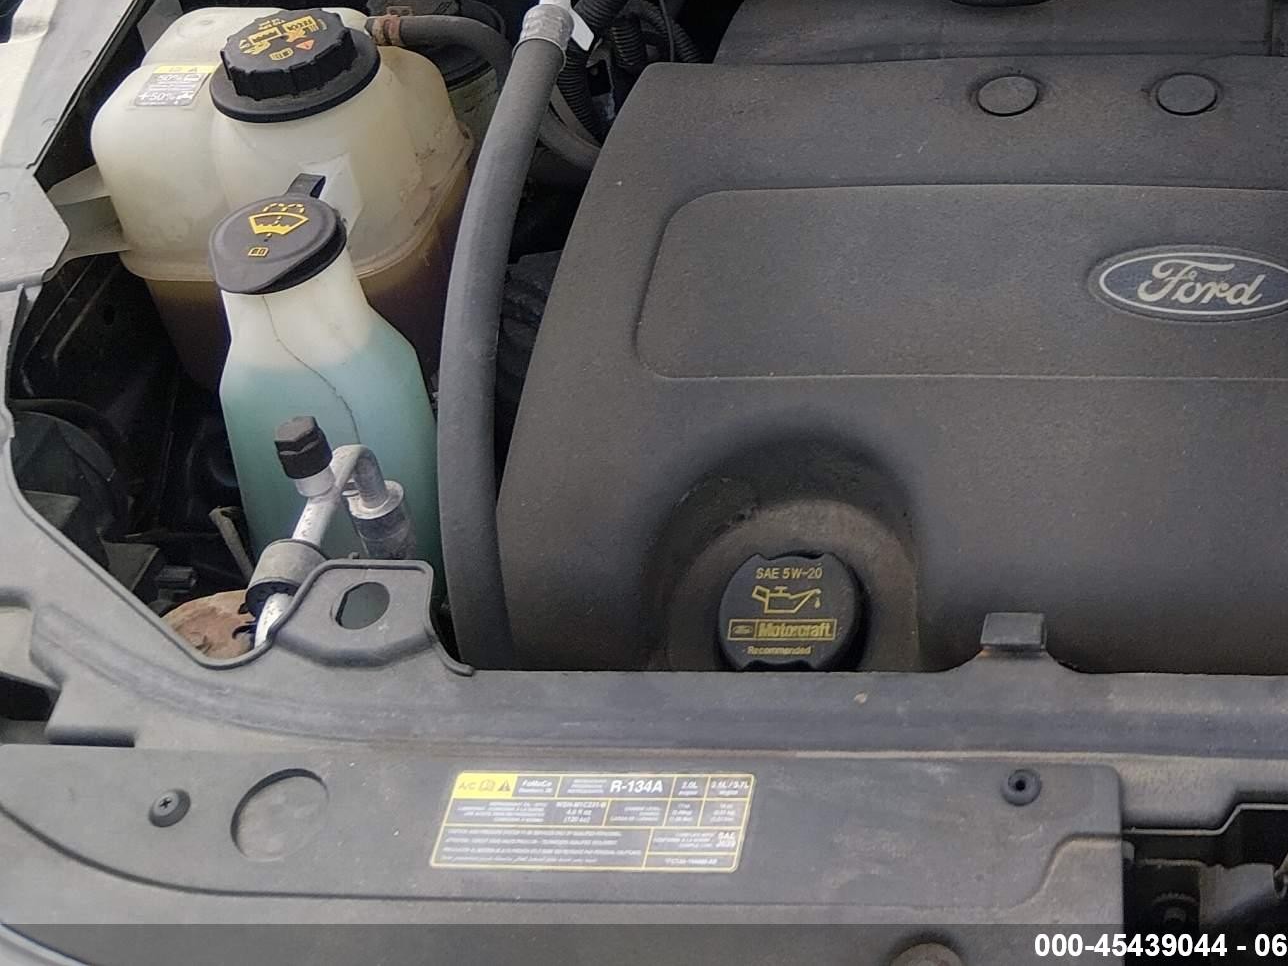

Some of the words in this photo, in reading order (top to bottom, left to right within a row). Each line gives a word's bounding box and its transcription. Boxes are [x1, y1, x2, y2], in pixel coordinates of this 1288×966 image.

[1137, 259, 1266, 306] Ford
[755, 567, 779, 579] SAE
[782, 567, 823, 579] 5W-20
[758, 622, 832, 639] Motorcraft
[747, 646, 811, 655] Recommended
[609, 779, 663, 793] R-134A
